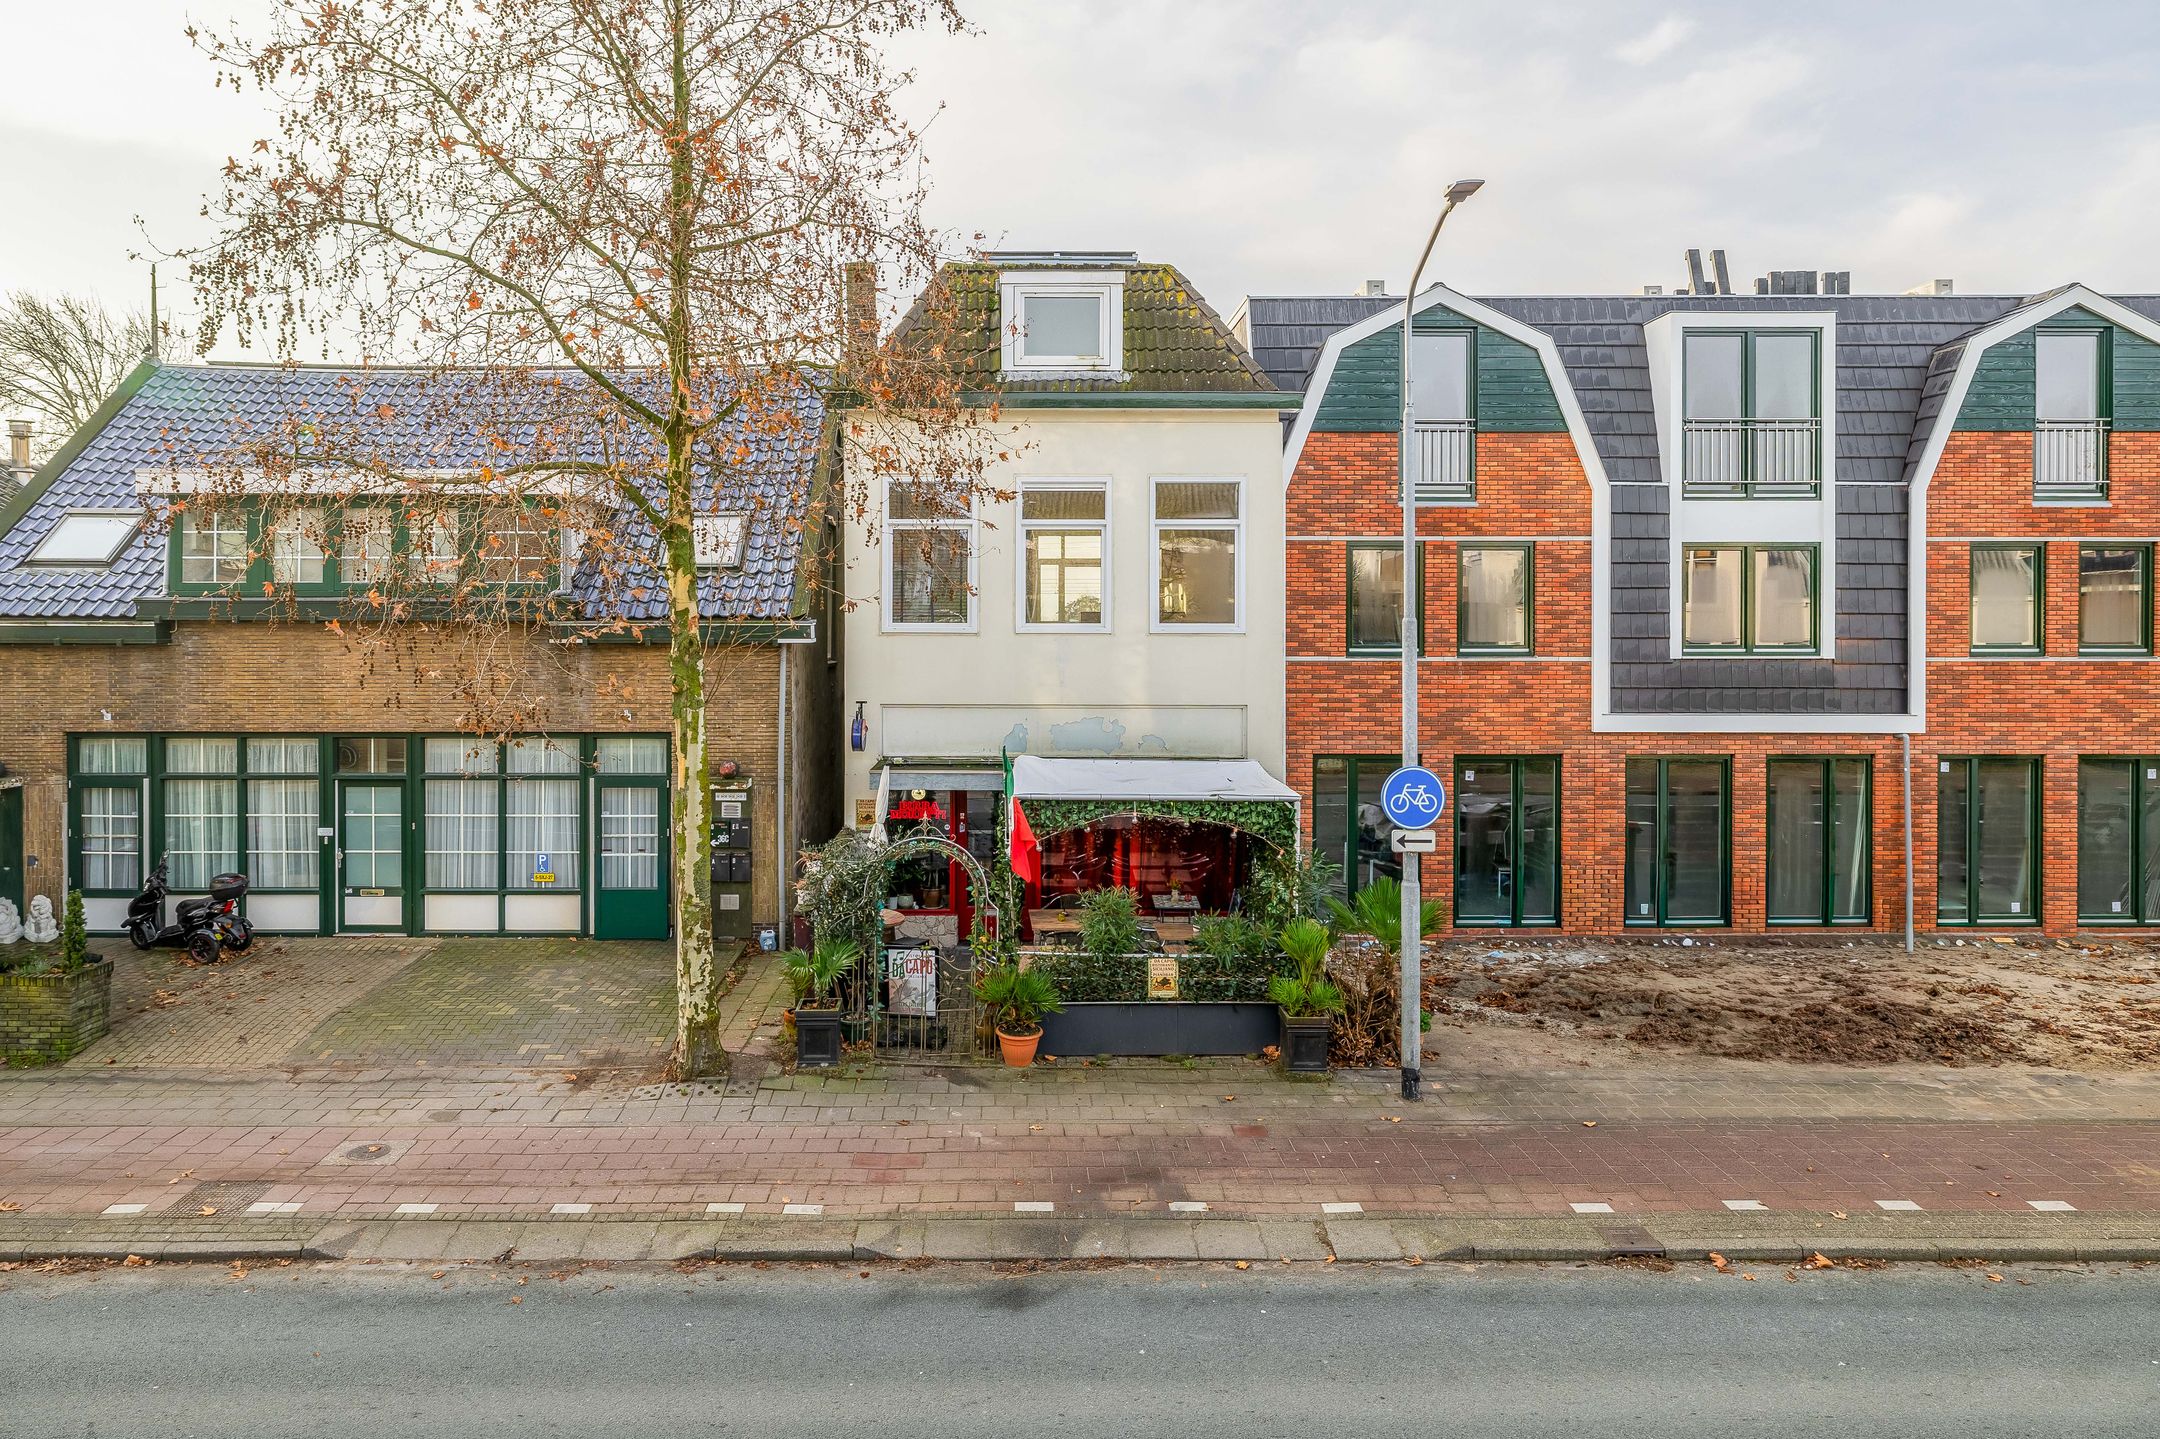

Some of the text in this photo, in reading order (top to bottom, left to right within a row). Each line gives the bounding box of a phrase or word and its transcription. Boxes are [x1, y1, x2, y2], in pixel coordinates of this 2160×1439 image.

[539, 855, 547, 865] P
[892, 959, 933, 978] DA CAPO
